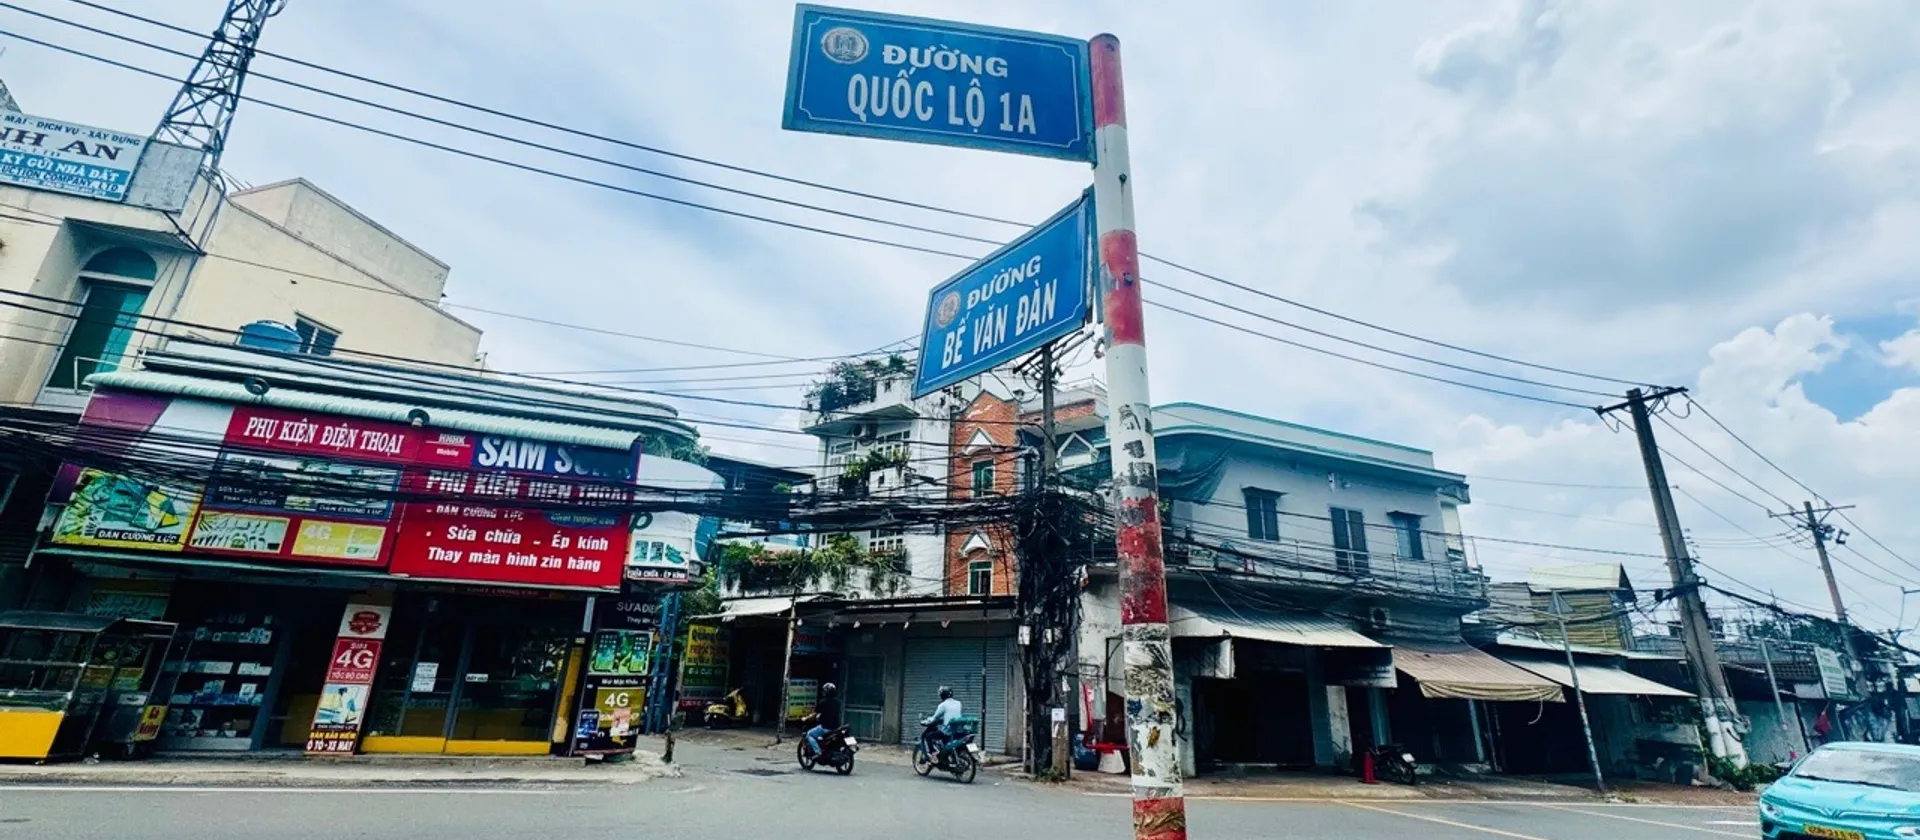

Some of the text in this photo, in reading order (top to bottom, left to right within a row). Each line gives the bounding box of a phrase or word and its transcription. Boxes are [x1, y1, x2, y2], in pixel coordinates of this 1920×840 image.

[882, 43, 1008, 78] ĐƯỜNG
[847, 66, 1036, 135] QUỐC LỘ 1A
[58, 140, 123, 161] AN
[966, 255, 1042, 310] ĐƯỜNG
[941, 278, 1058, 370] BẾ VĂN ĐÀN
[243, 416, 406, 456] PHỤ KIỆN ĐIỆN THOẠI
[477, 436, 548, 471] SAM
[447, 523, 608, 551] Sửa chữa Ép kính
[427, 546, 602, 573] Thay màn hình zin hãng
[336, 649, 375, 670] 4G
[605, 692, 629, 708] 4G
